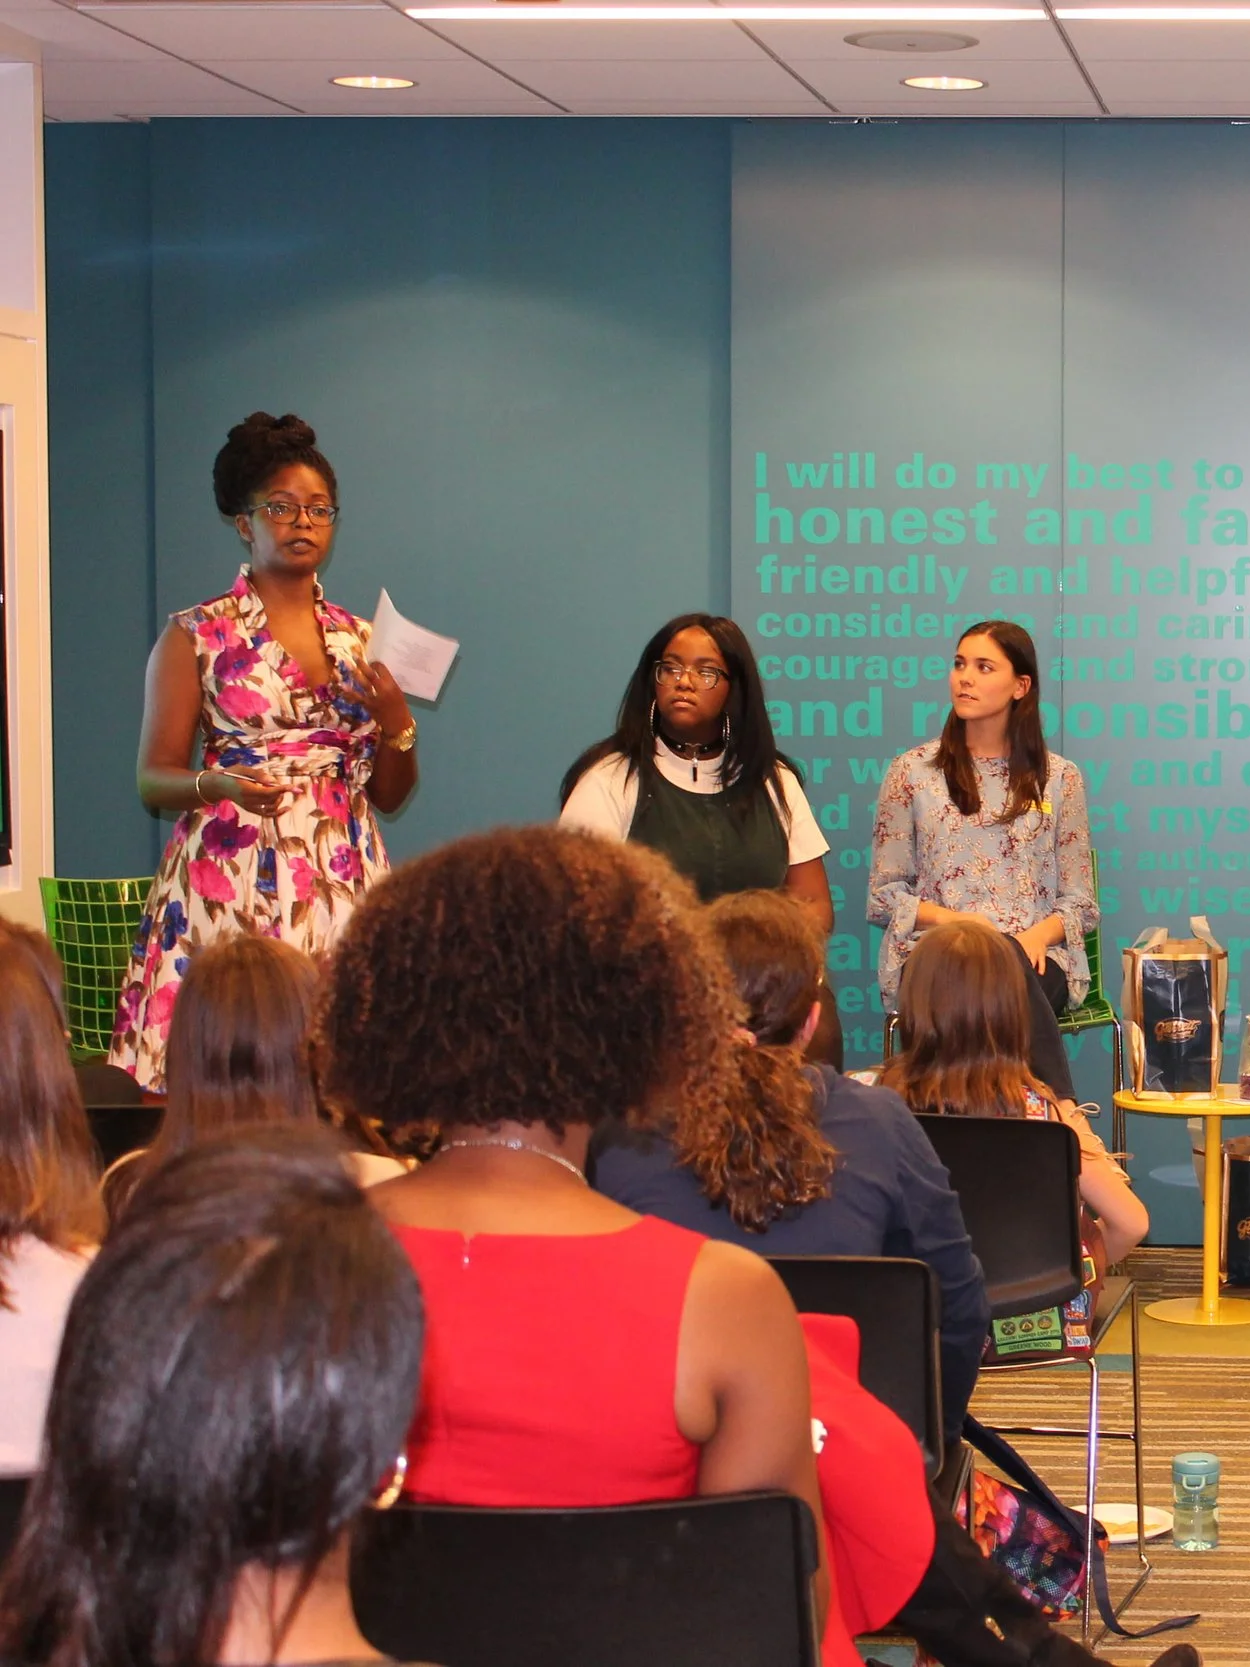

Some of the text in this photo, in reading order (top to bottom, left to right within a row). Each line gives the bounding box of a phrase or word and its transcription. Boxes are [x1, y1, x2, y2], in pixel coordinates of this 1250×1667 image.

[754, 452, 768, 488] I
[785, 451, 876, 489] will
[895, 452, 956, 489] do
[976, 463, 1049, 498] my
[1067, 453, 1174, 490] best
[1193, 459, 1243, 490] to
[754, 492, 998, 545] honest
[1024, 493, 1152, 545] and
[756, 553, 969, 606] friendly
[989, 556, 1088, 595] and
[1052, 605, 1138, 639] and
[758, 654, 954, 689] courage
[1048, 648, 1135, 682] and
[765, 686, 884, 739] and
[1129, 750, 1222, 787] and
